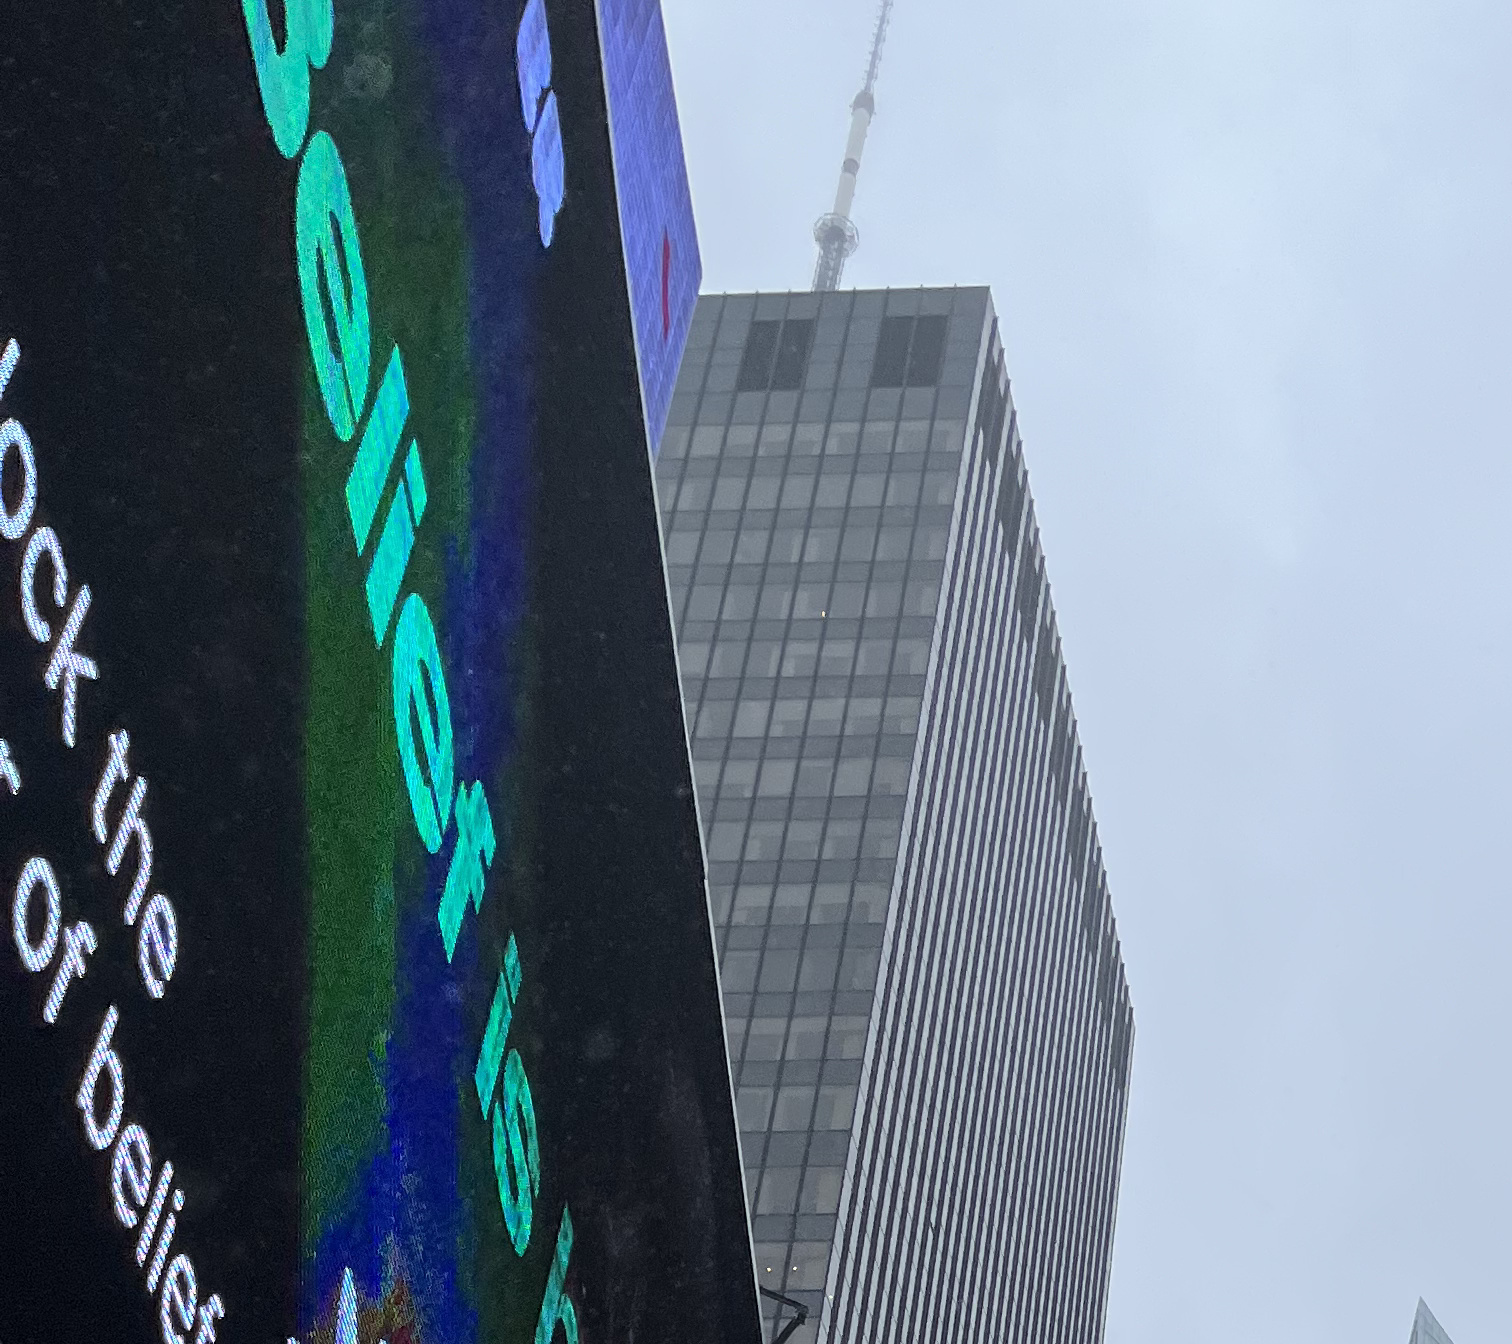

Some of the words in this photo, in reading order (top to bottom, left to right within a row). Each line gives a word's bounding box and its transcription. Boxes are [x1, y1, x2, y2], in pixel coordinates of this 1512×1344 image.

[12, 856, 97, 1024] of
[92, 730, 178, 1000] the
[474, 931, 541, 1257] is
